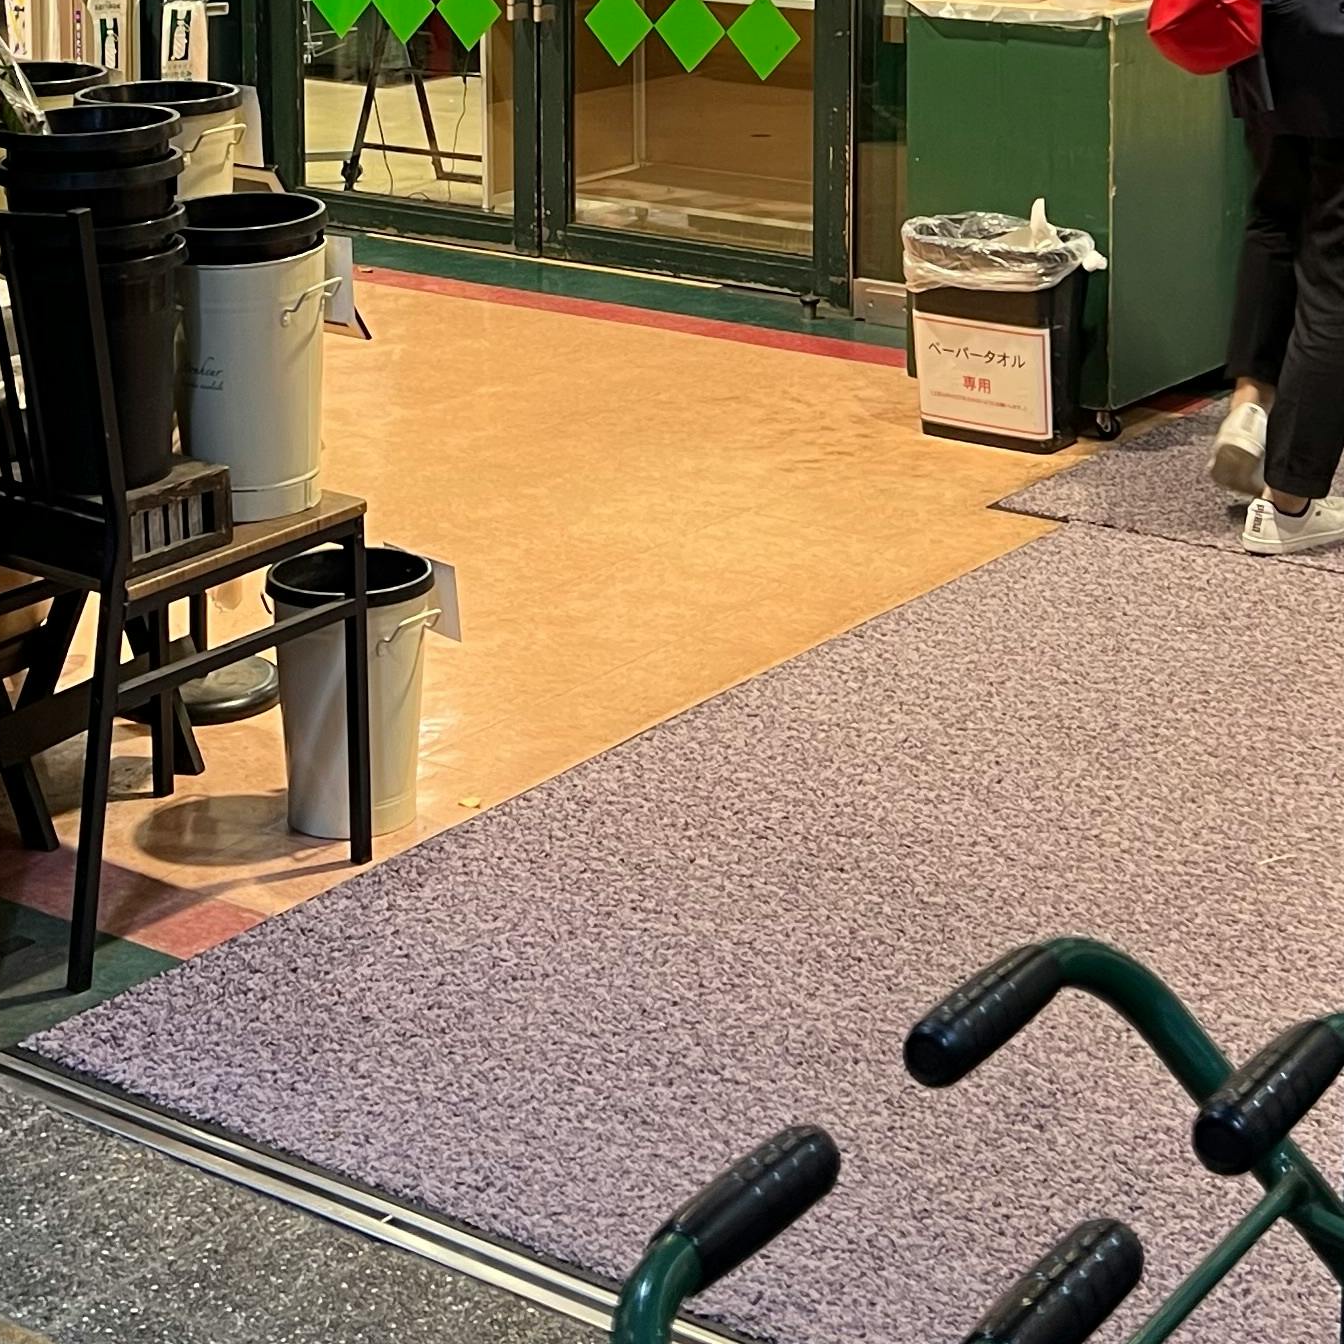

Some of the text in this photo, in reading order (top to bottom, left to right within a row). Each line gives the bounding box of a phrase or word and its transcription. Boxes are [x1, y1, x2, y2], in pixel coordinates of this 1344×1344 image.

[928, 342, 1026, 368] ペーパータオル
[962, 375, 992, 395] 専用
